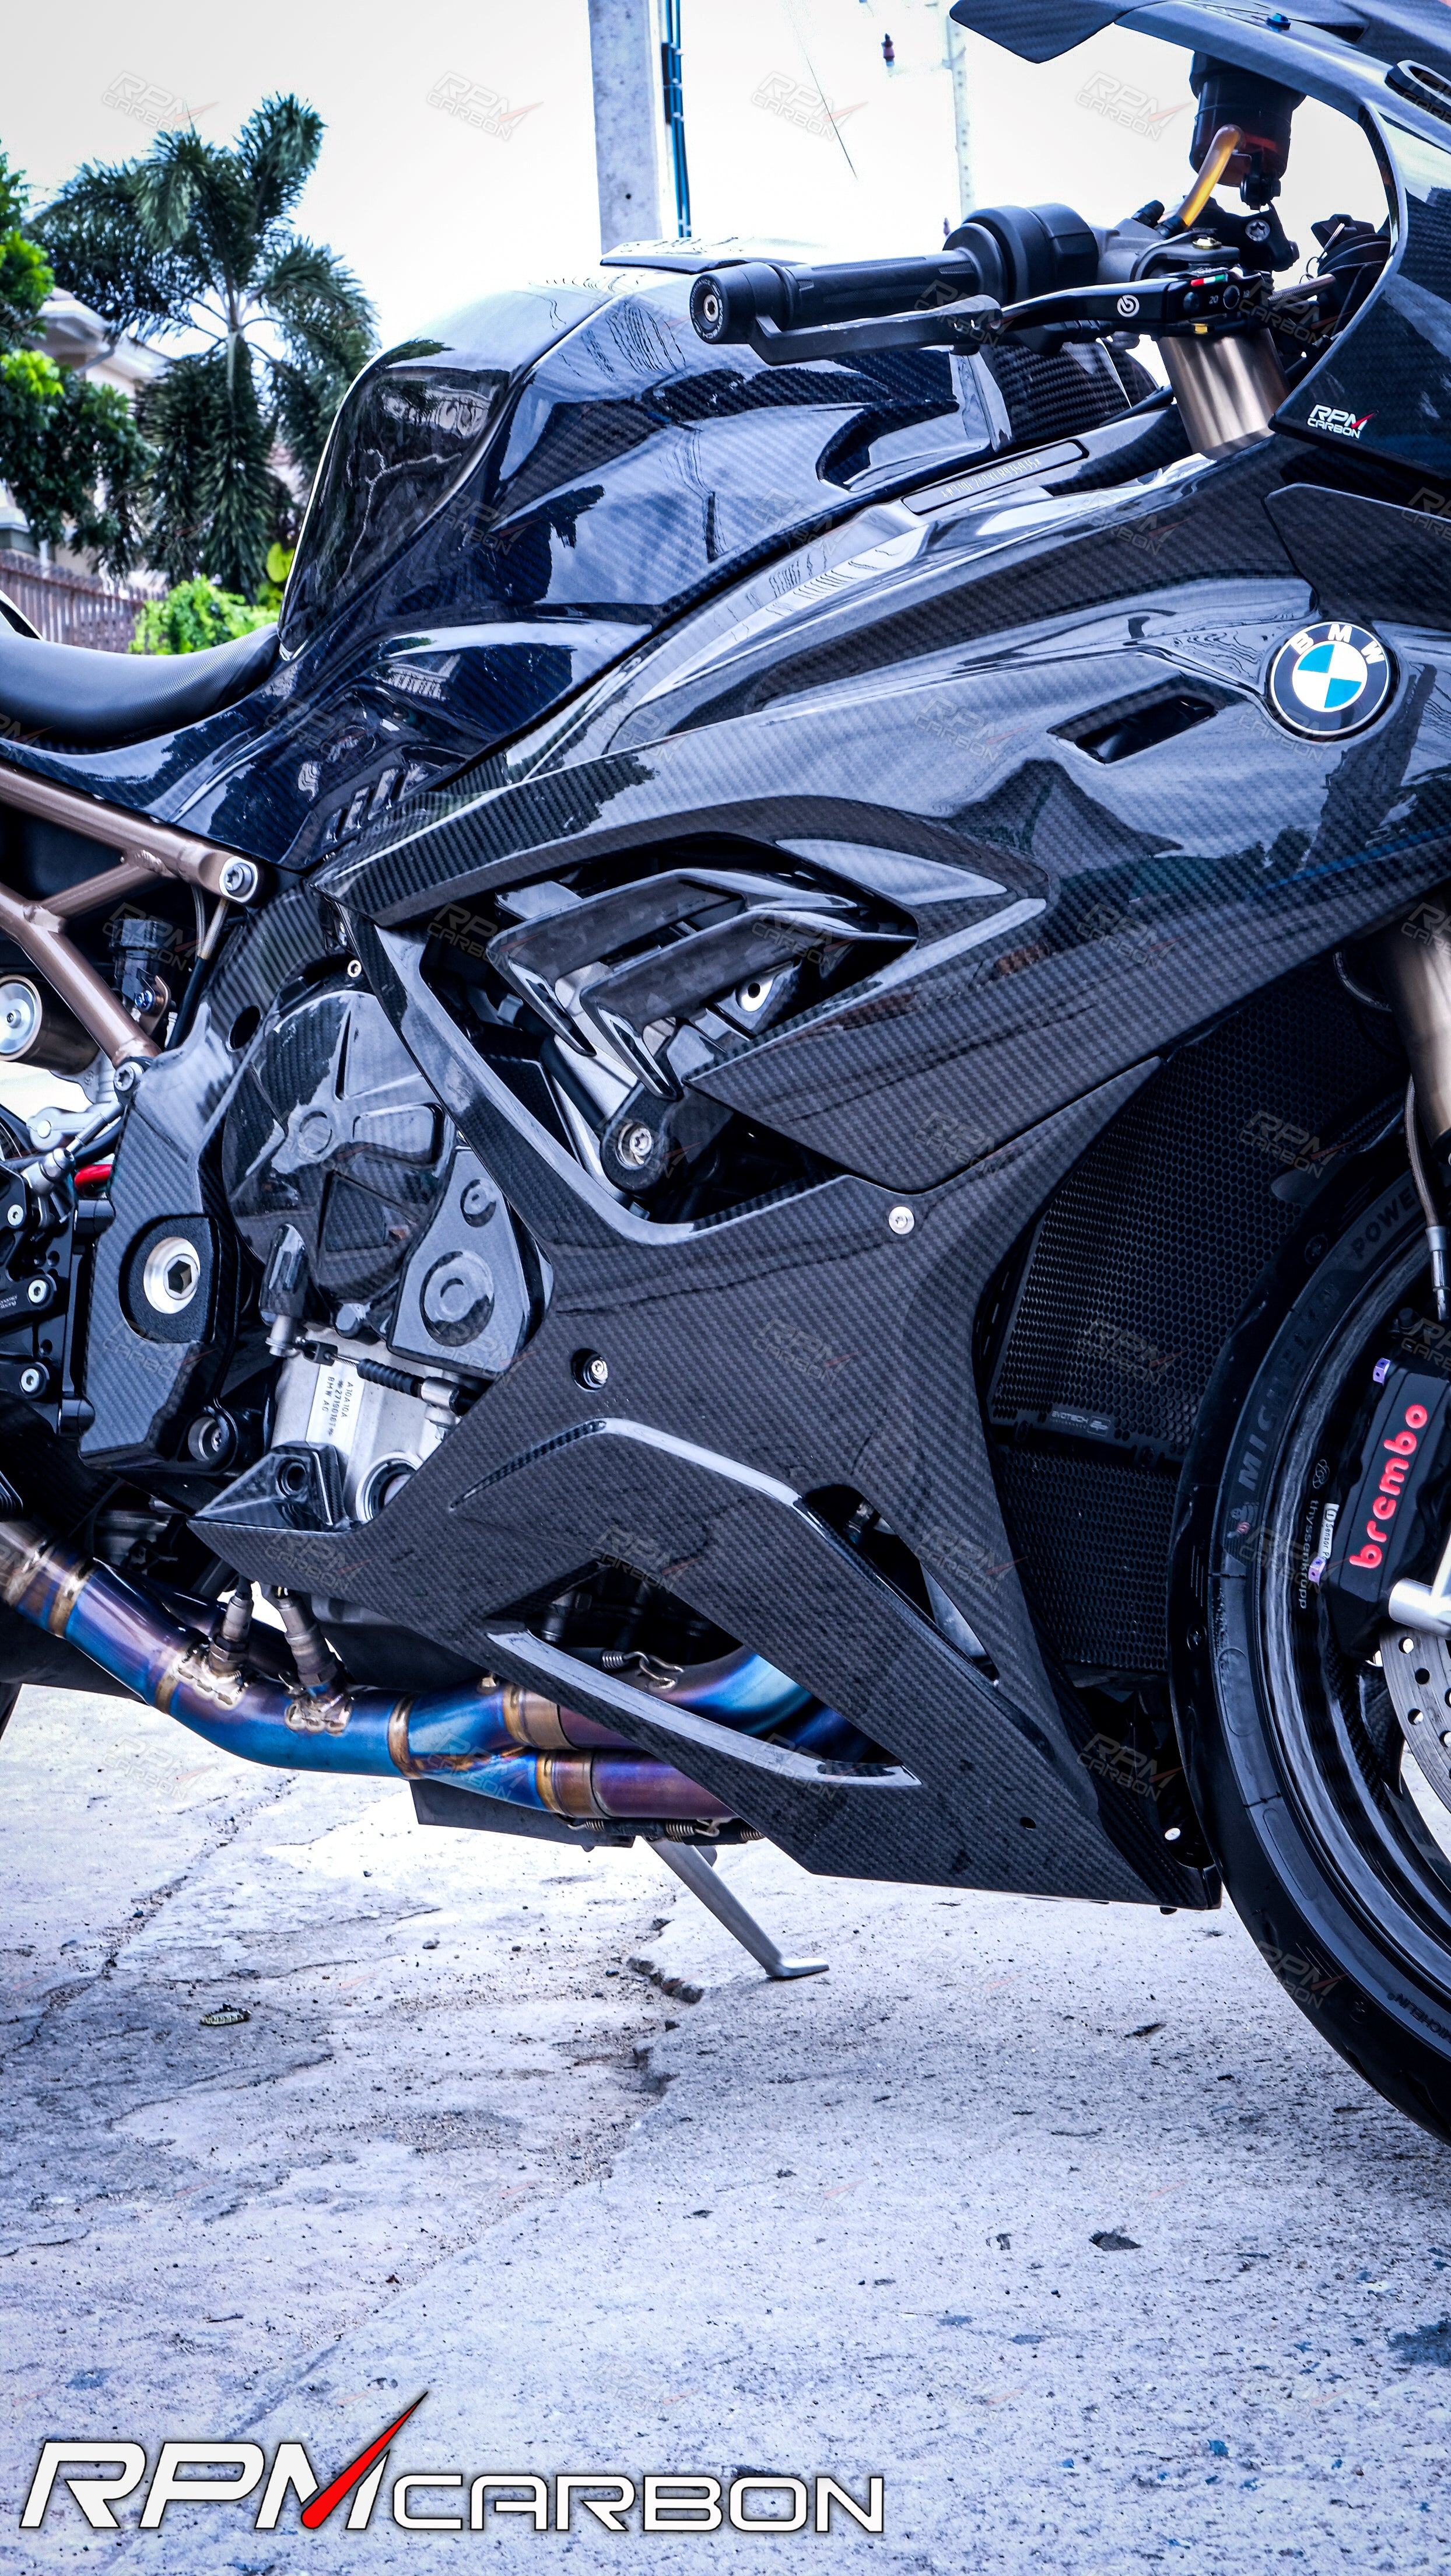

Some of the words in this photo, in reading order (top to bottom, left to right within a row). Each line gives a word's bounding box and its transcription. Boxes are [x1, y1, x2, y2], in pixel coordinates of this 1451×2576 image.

[1209, 295, 1219, 304] 20
[1307, 418, 1361, 439] CARBON
[1310, 404, 1377, 430] RPM
[1289, 624, 1385, 664] BMW
[325, 1376, 335, 1397] BMW
[1238, 1278, 1341, 1492] MICHELIN
[1350, 1403, 1428, 1569] brembo
[1323, 1523, 1334, 1549] Sensor
[1299, 1500, 1319, 1609] thyssenkrupp
